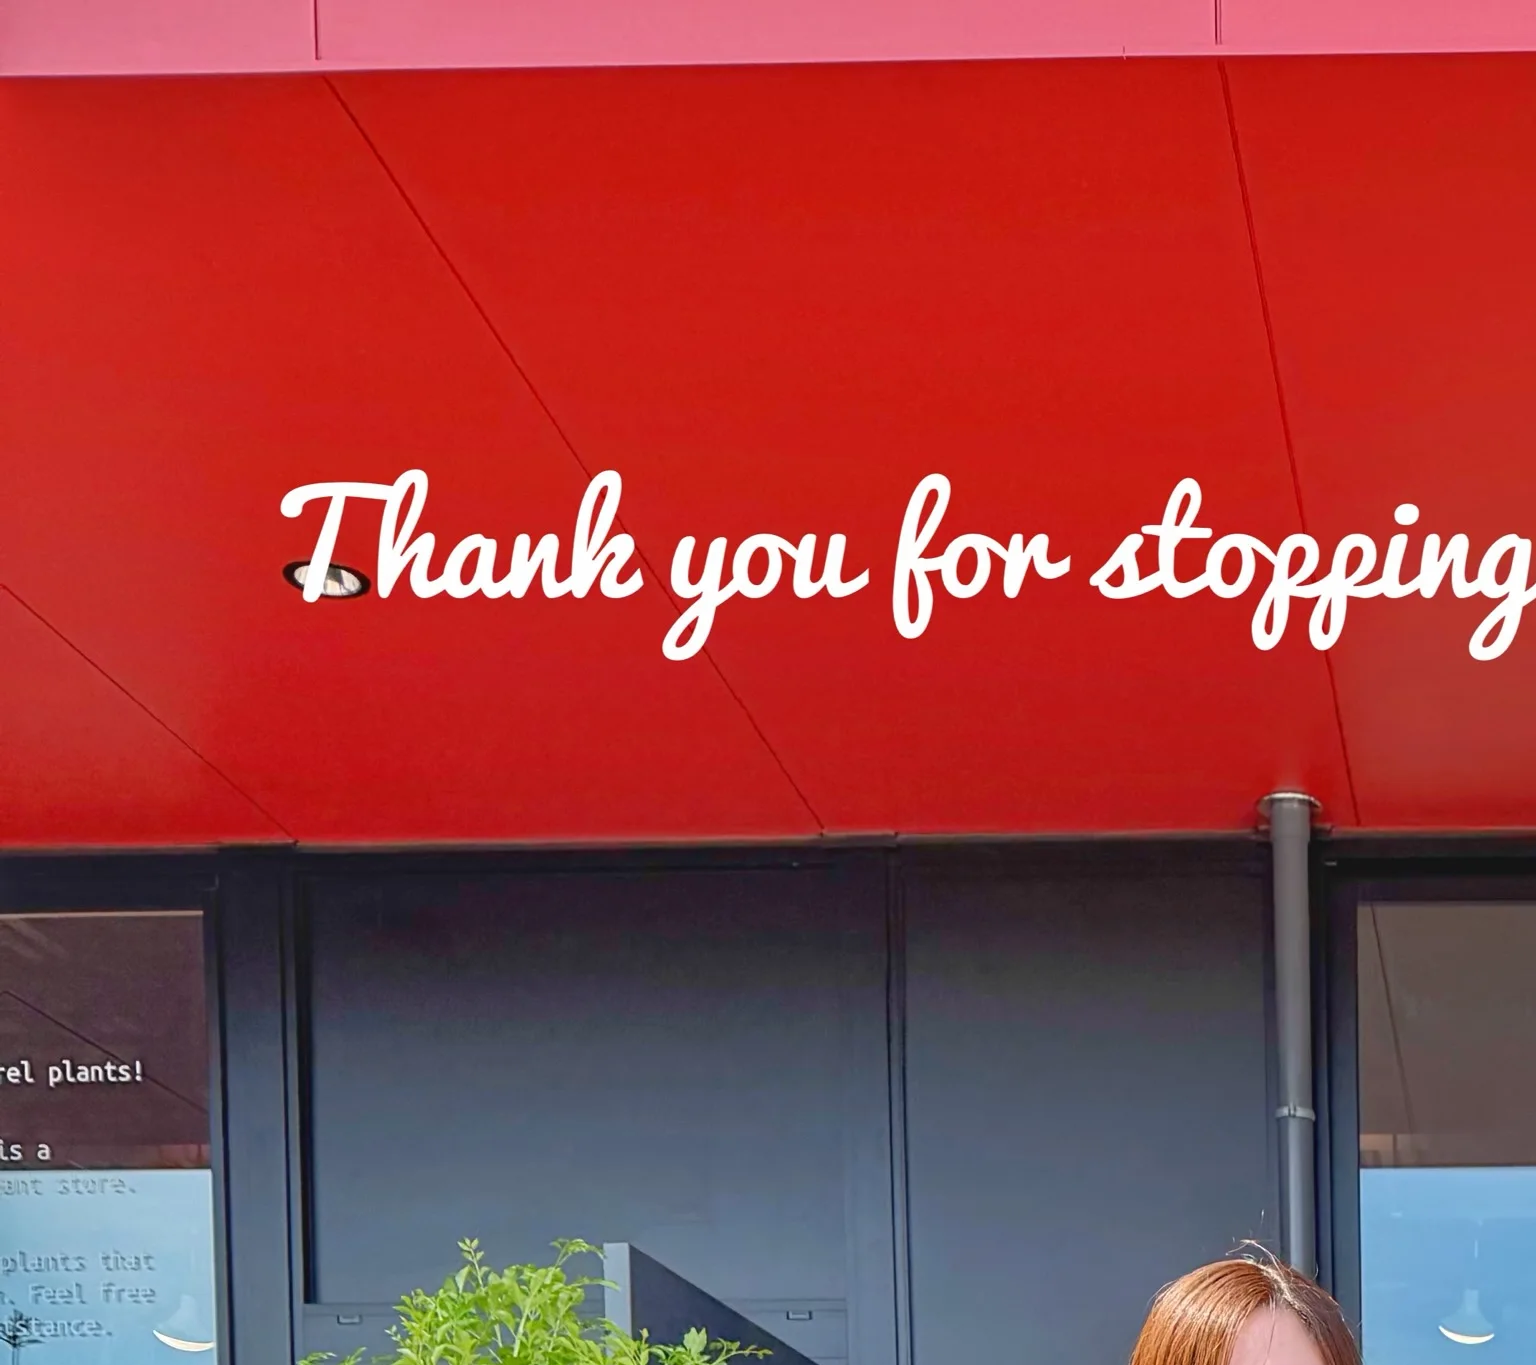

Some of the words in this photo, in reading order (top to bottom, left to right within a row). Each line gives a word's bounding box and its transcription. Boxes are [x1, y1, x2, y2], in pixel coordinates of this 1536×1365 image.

[49, 1060, 143, 1087] plants!
[37, 1143, 52, 1161] a
[2, 1249, 86, 1276] plants
[101, 1249, 156, 1272] that
[29, 1281, 87, 1305] Feel
[101, 1281, 156, 1304] free
